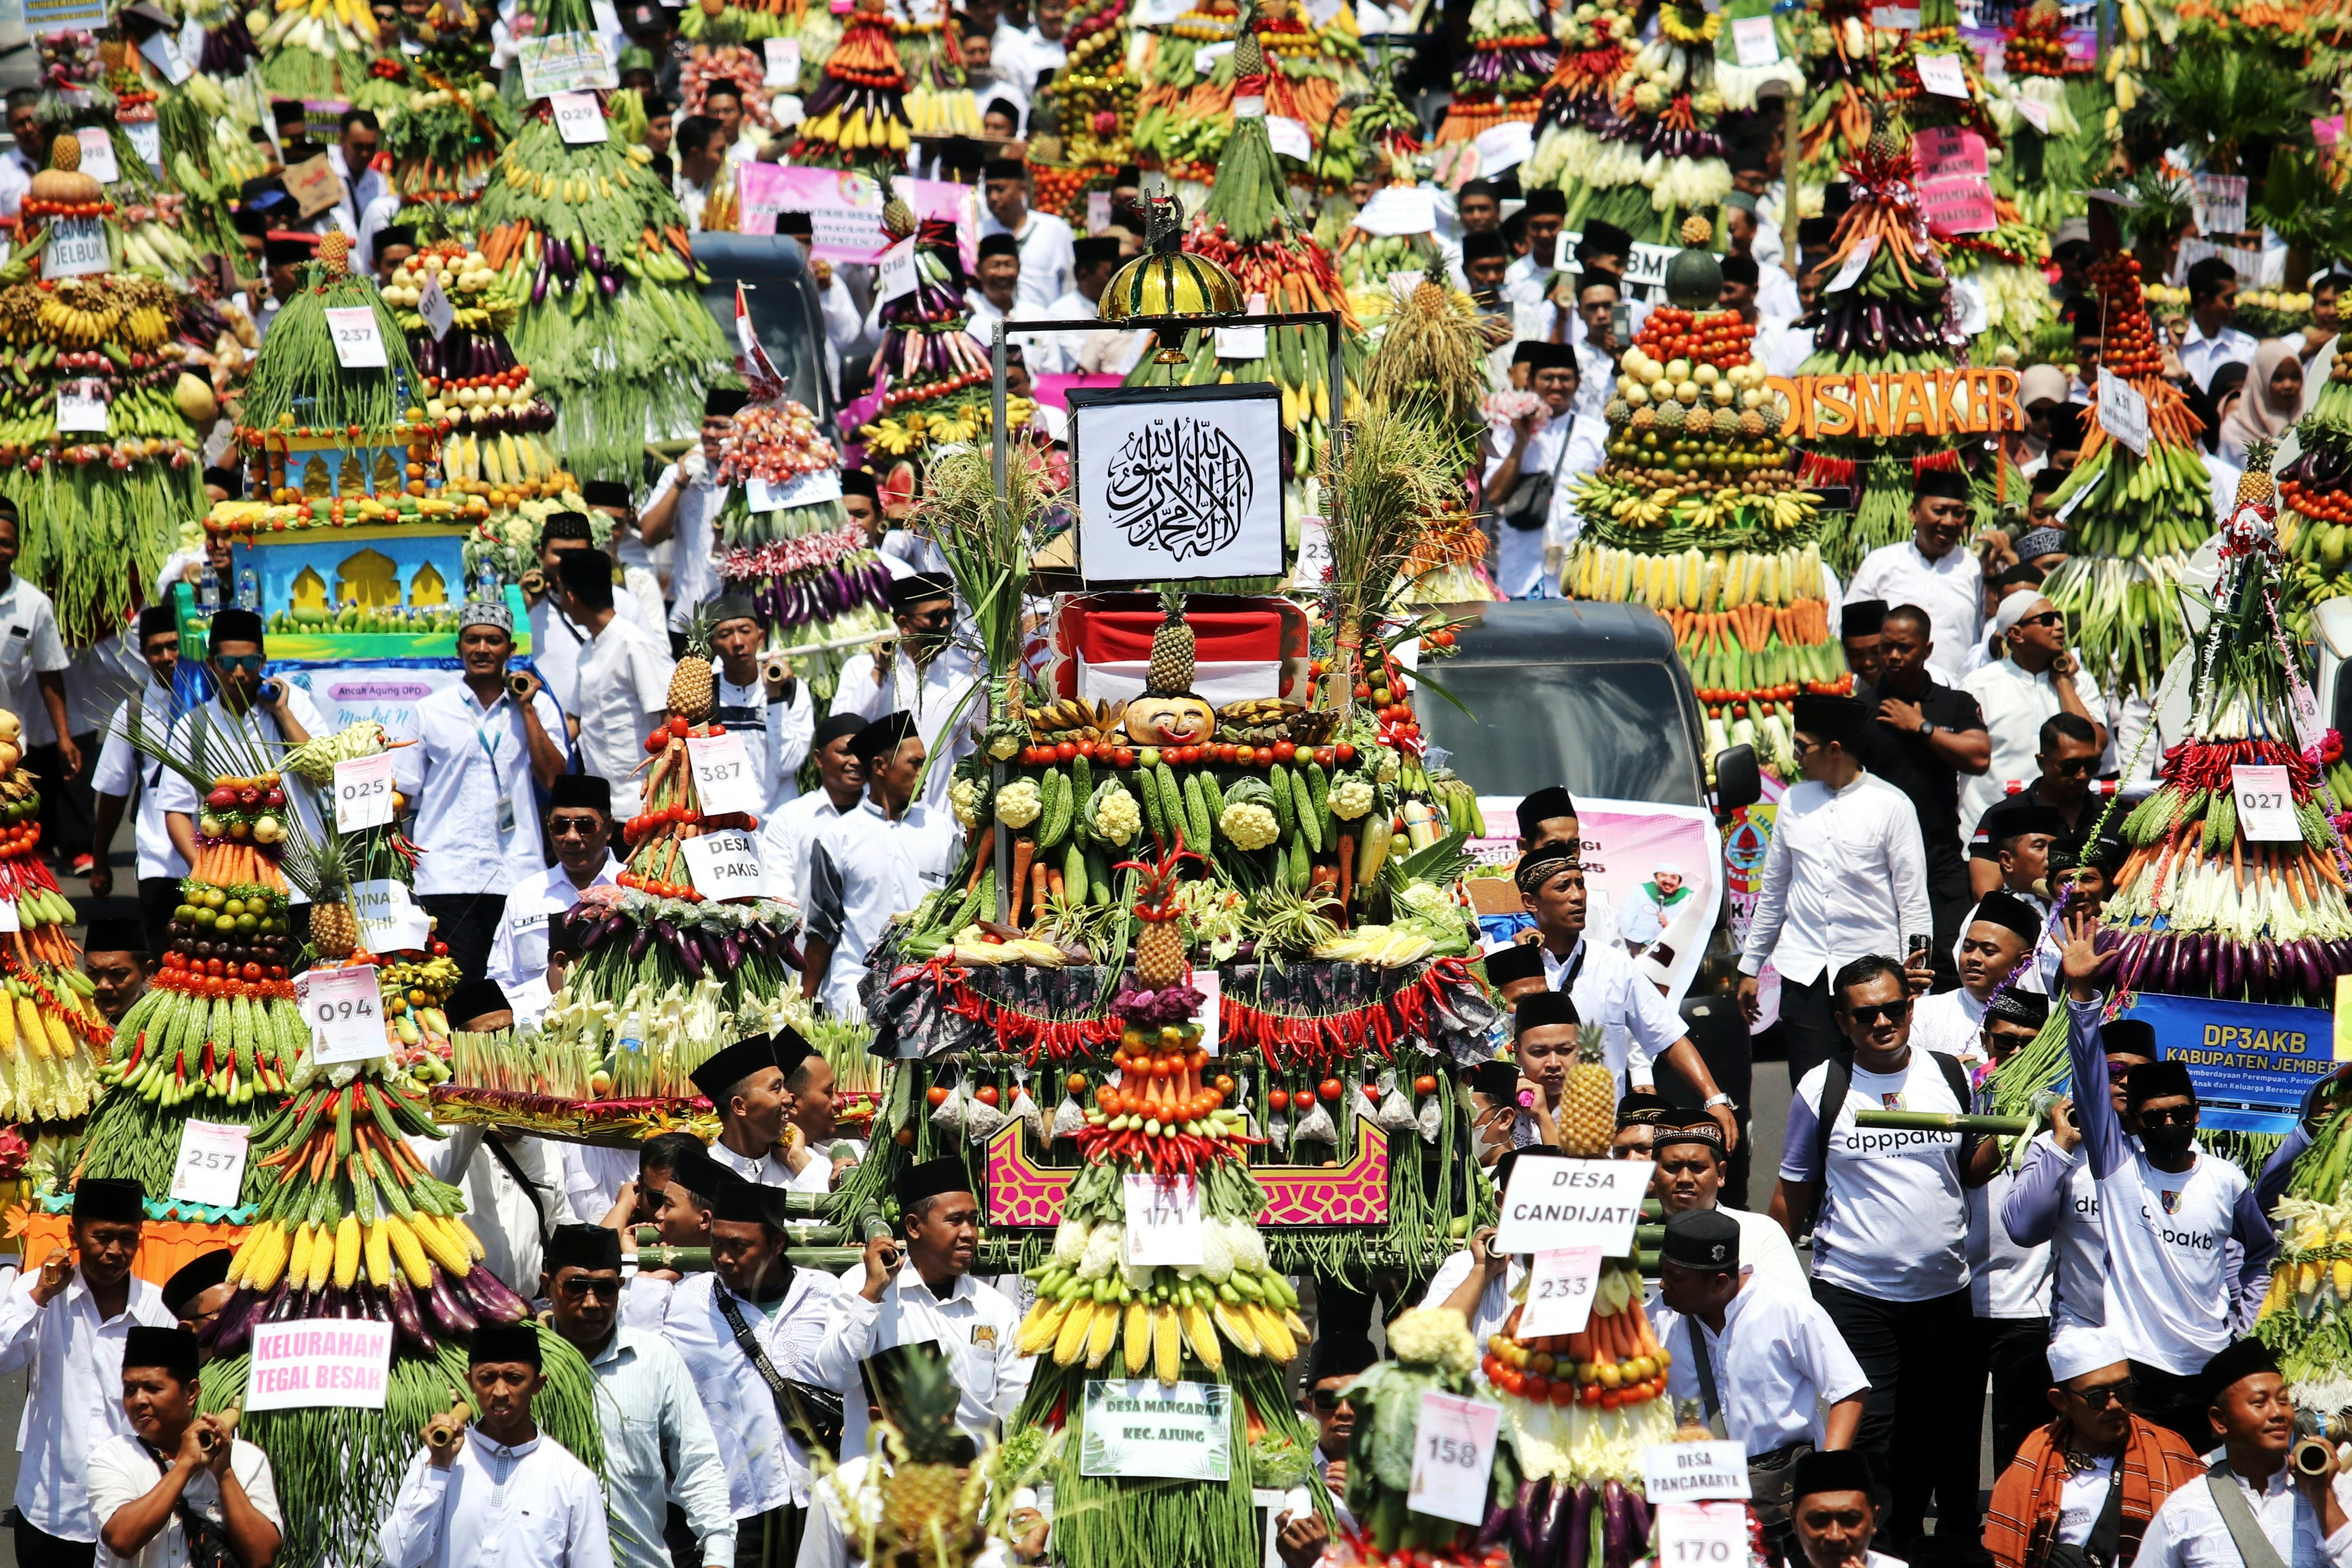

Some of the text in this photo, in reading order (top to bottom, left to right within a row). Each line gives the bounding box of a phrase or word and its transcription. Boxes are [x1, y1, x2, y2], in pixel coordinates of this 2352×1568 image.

[562, 109, 592, 120] 029
[883, 256, 906, 274] 018
[423, 290, 440, 316] 017
[340, 330, 371, 341] 237
[1766, 367, 2025, 439] DISNAKER
[1306, 544, 1331, 559] 23
[339, 686, 422, 697] Ancak Agung OPD
[699, 761, 741, 783] 387
[343, 780, 385, 801] 025
[2243, 793, 2284, 809] 027
[708, 838, 750, 855] DESA
[713, 863, 759, 880] PAKIS
[318, 997, 375, 1024] 094
[2204, 1025, 2307, 1054] DP3AKB
[2166, 1047, 2270, 1071] KABUPATEN
[2229, 1082, 2263, 1094] Keluarga
[2243, 1073, 2289, 1084] Perempuan,
[188, 1150, 238, 1171] 257
[1552, 1171, 1615, 1189] DESA
[1142, 1207, 1184, 1226] 171
[1513, 1204, 1637, 1225] CANDIJATI
[1539, 1277, 1588, 1300] 233
[257, 1332, 385, 1362] KELURAHAN
[255, 1365, 382, 1394] TEGAL BESAR
[1107, 1401, 1223, 1417] DESA MANGARAN
[1123, 1427, 1205, 1443] KEC. AJUNG
[1430, 1437, 1477, 1468] 158
[1677, 1453, 1713, 1469] DESA
[1652, 1474, 1740, 1494] PANCAKARYA
[1673, 1540, 1729, 1562] 170
